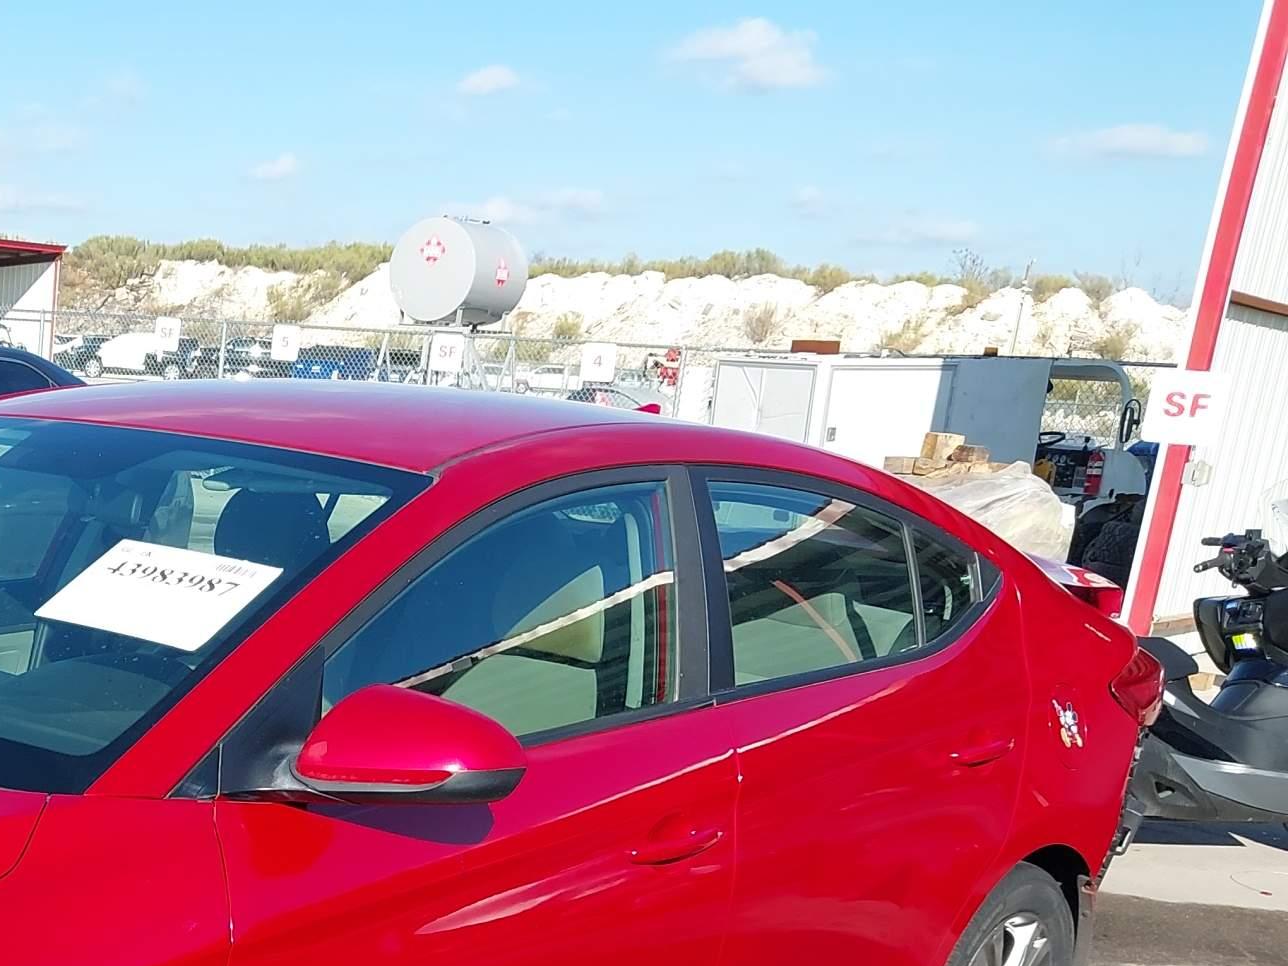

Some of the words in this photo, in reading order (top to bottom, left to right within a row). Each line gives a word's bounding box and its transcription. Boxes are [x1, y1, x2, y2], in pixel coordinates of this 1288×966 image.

[439, 345, 457, 358] SF
[592, 355, 602, 368] 4
[1164, 392, 1211, 416] SF
[107, 560, 240, 596] 43983987
